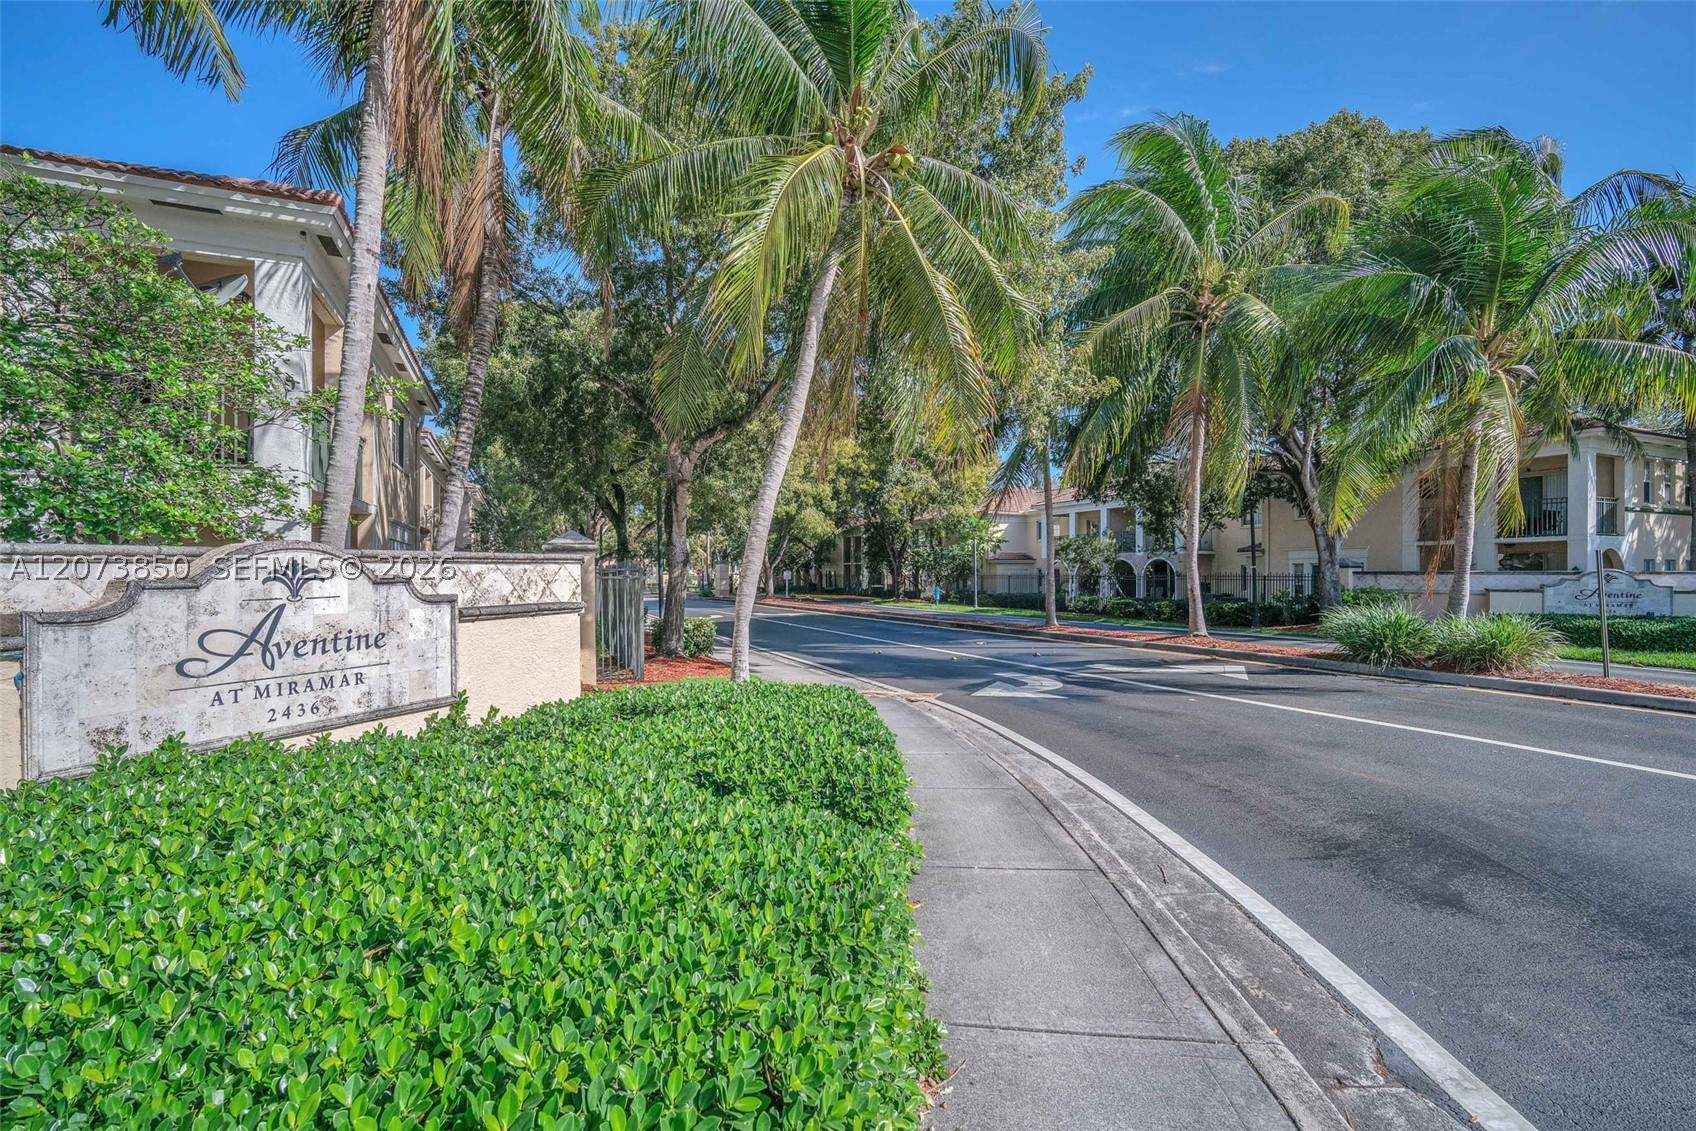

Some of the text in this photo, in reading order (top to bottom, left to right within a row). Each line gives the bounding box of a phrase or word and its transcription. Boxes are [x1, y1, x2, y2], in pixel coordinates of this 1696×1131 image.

[175, 603, 388, 679] Aventine
[209, 671, 366, 707] AT MIRAMAR
[267, 700, 320, 723] 2436
